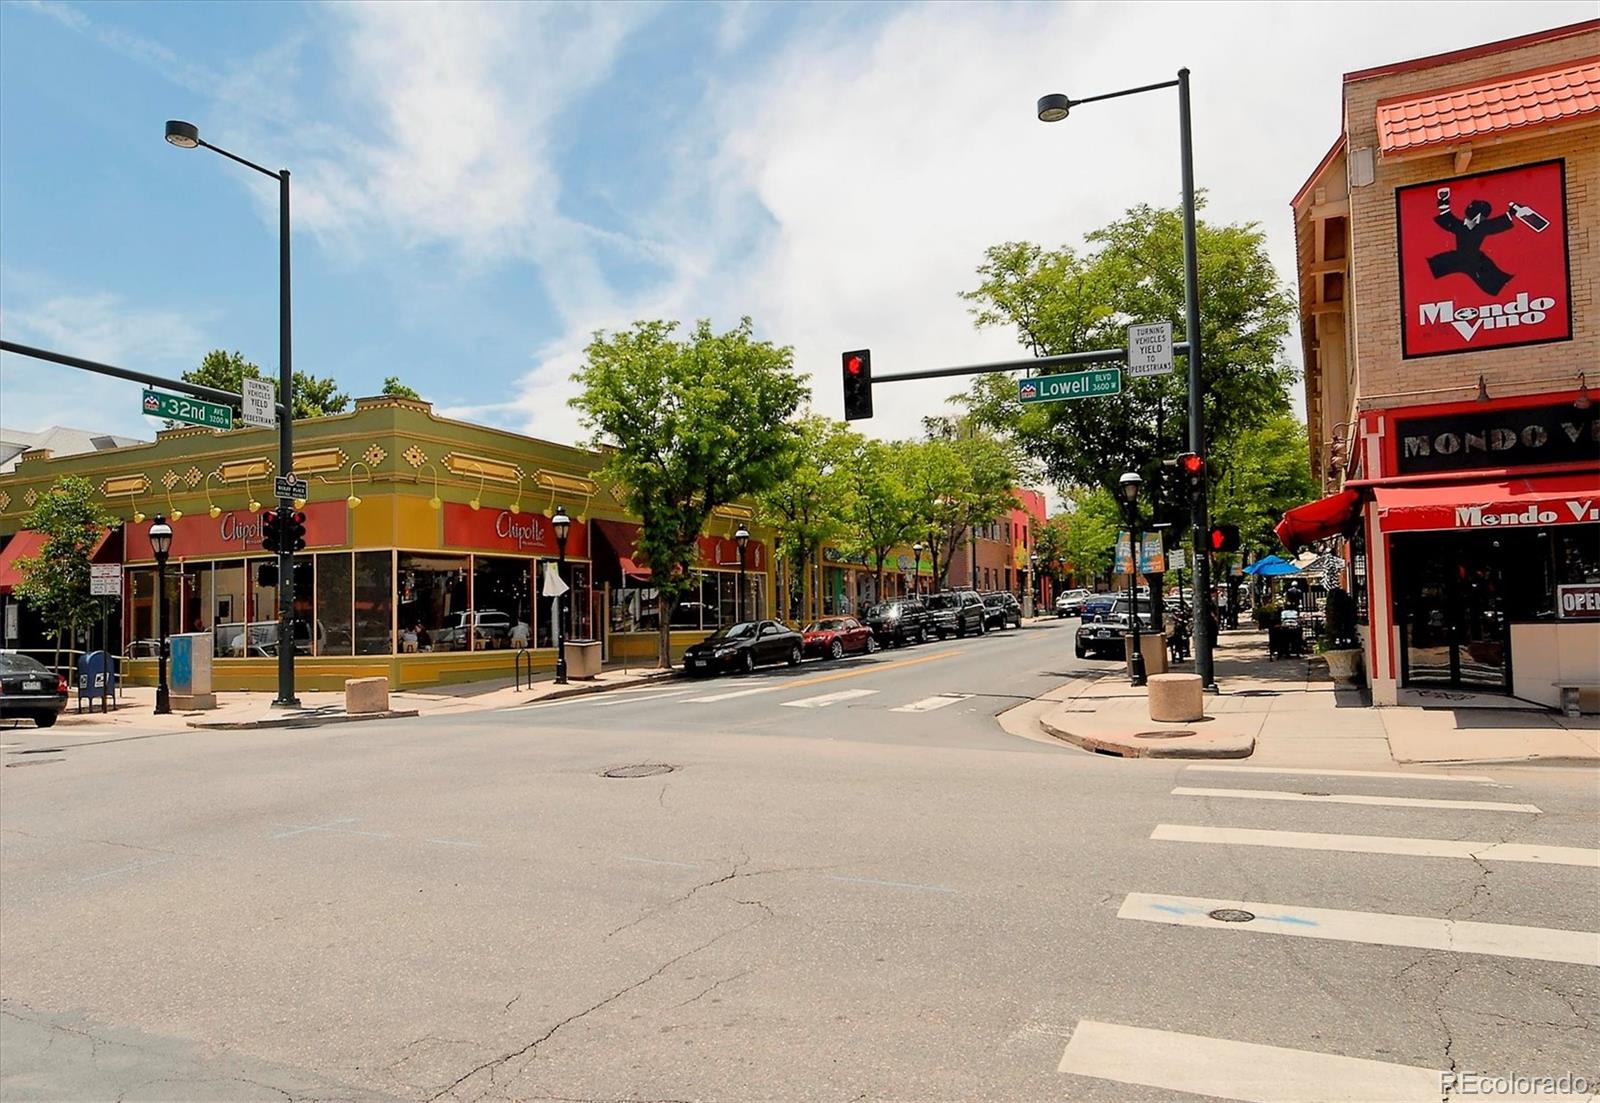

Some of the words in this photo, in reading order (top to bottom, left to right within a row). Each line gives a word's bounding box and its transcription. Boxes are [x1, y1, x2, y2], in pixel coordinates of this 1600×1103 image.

[1419, 292, 1556, 326] Mondo
[1136, 326, 1165, 336] TURNING
[1451, 310, 1547, 342] Vino
[1135, 335, 1167, 345] VEHICLES
[1140, 344, 1163, 354] YIELD
[1147, 355, 1156, 363] TO
[1131, 361, 1172, 373] PEDESTRIANS
[1095, 373, 1112, 382] BLVD
[248, 381, 269, 392] TURNING
[1040, 376, 1089, 396] Lowell
[1092, 382, 1110, 391] 3600
[247, 389, 271, 400] VEHICLES
[251, 398, 269, 409] YIELD
[168, 399, 206, 421] 32nd
[213, 408, 224, 417] AVE
[209, 415, 224, 424] 3200
[243, 413, 274, 425] PEDESTRIANS
[1404, 425, 1548, 458] MONDO
[1455, 504, 1558, 527] Mondo
[221, 512, 264, 550] Chipotl
[496, 511, 545, 550] Chipotle
